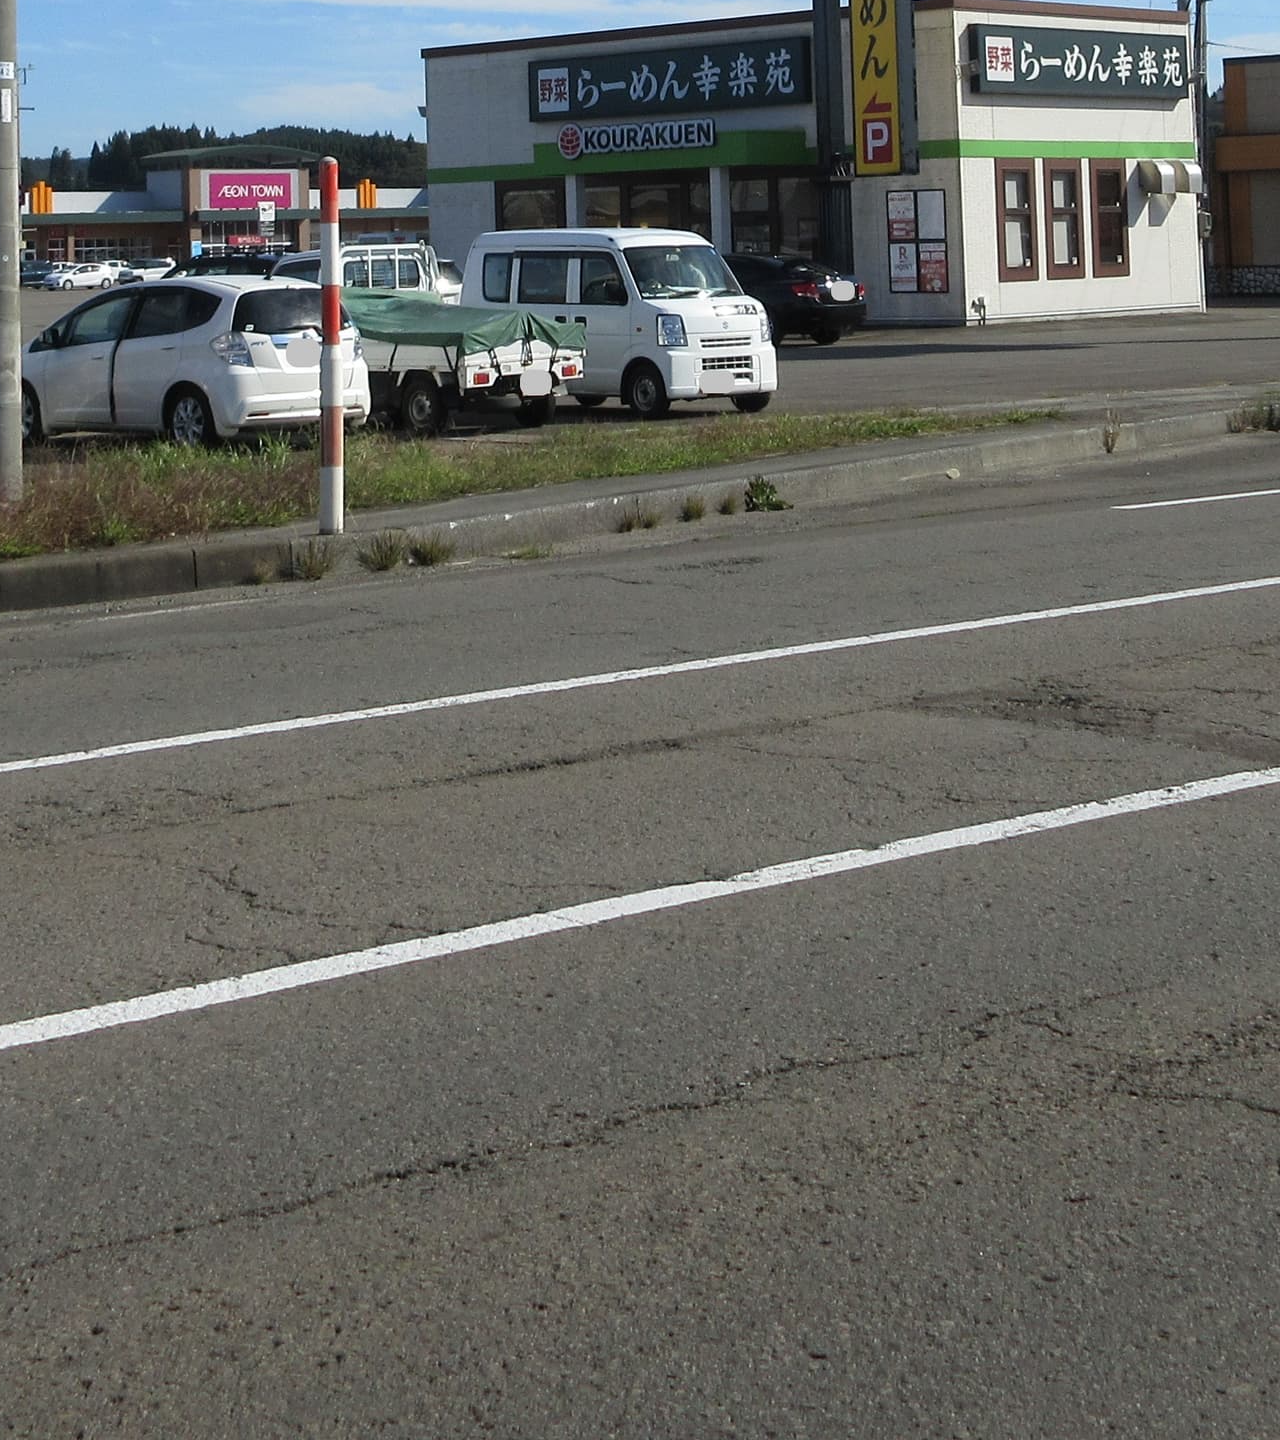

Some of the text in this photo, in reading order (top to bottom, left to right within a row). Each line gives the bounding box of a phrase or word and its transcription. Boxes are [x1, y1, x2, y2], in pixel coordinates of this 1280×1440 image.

[584, 123, 713, 151] KOURAKUEN
[866, 122, 889, 161] P
[251, 185, 283, 197] TOWN
